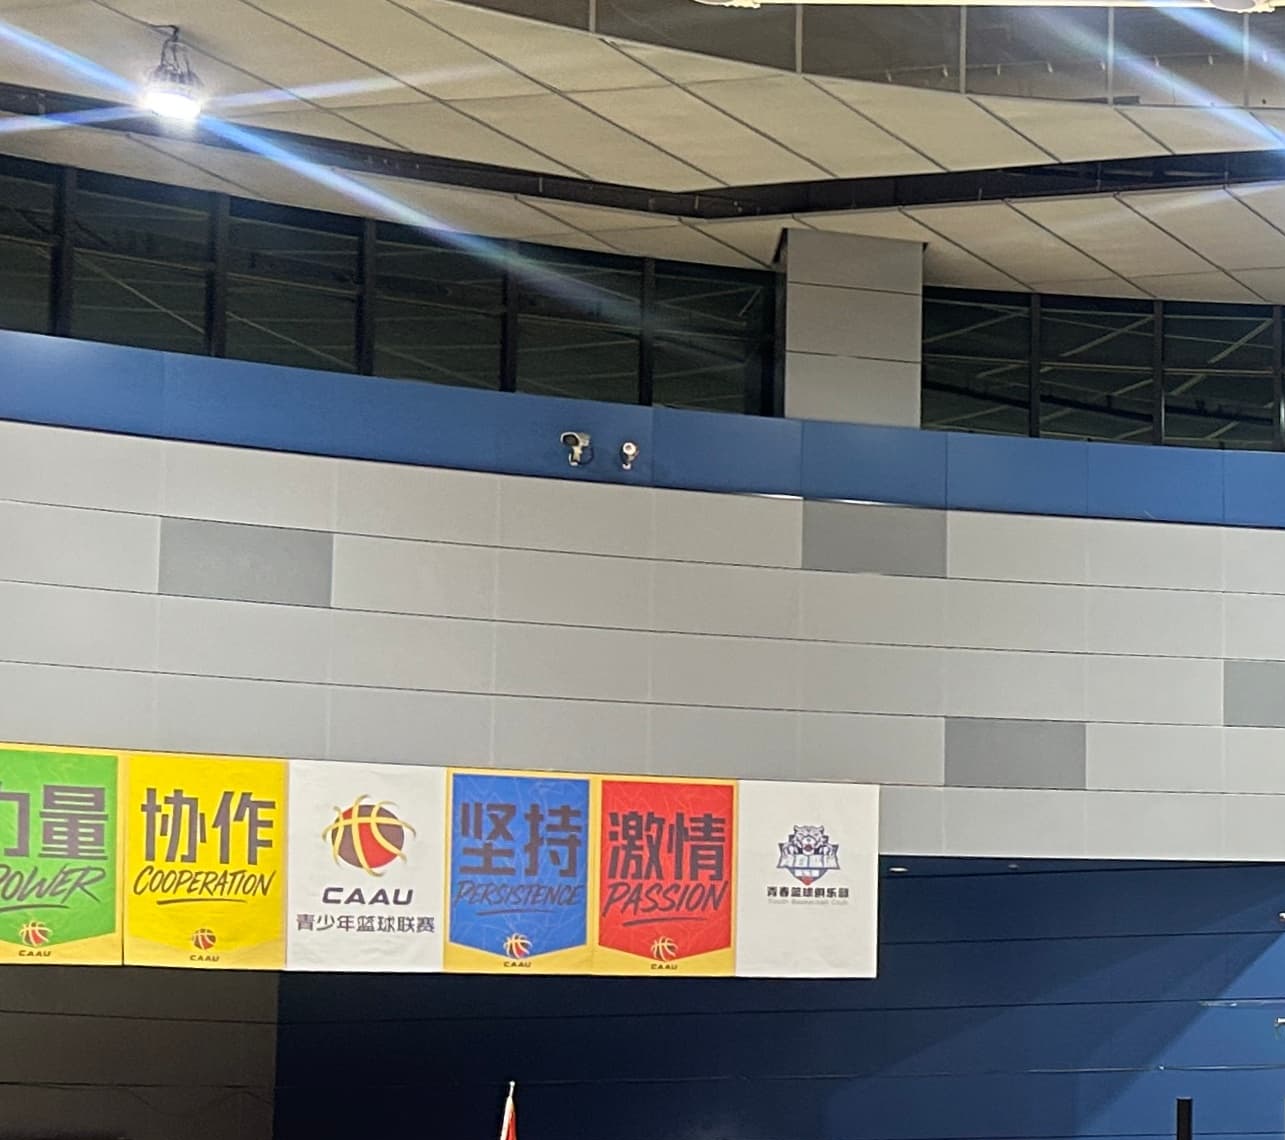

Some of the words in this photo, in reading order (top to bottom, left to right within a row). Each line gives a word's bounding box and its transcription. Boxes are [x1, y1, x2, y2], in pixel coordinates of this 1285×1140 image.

[141, 787, 276, 865] 协作
[459, 802, 583, 877] 坚持
[607, 811, 727, 881] 激情
[133, 865, 277, 897] COOPERATION
[322, 886, 414, 906] CAAU
[455, 879, 586, 907] PERSISTENCE
[601, 881, 729, 918] PASSION
[296, 913, 436, 933] 青少年篮球联赛
[18, 949, 52, 957] CAAU
[189, 954, 220, 962] CAAU
